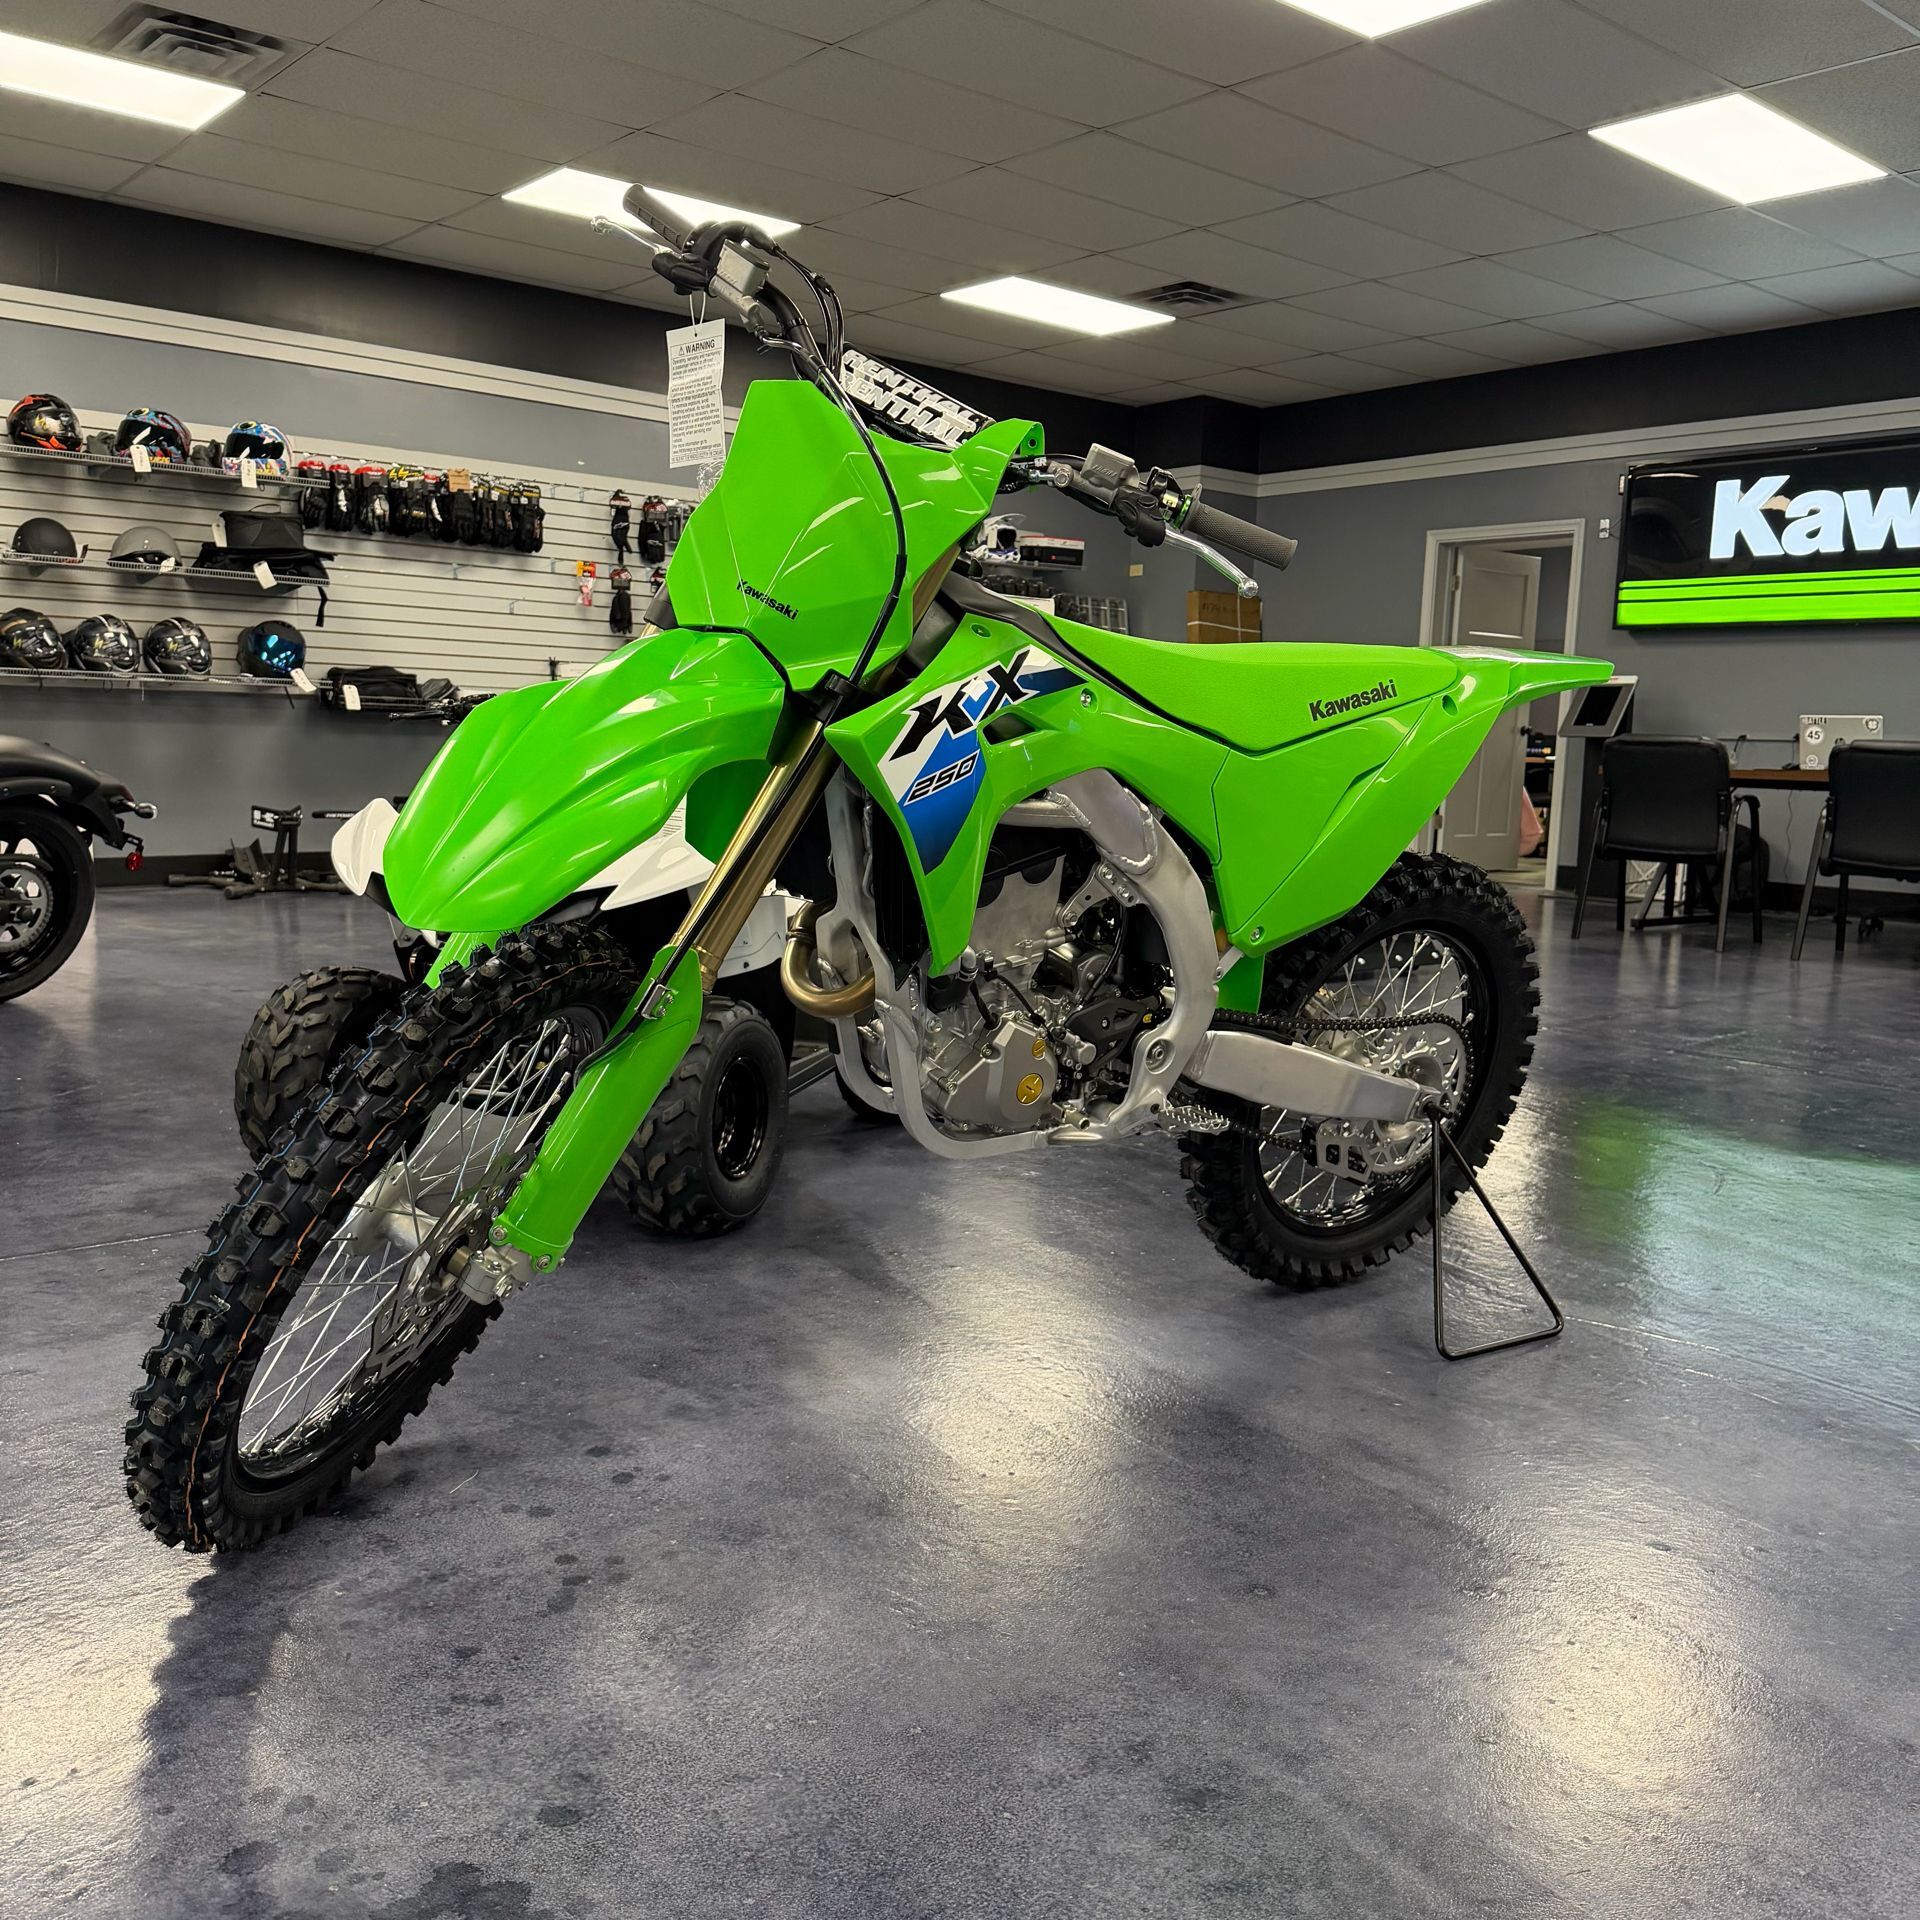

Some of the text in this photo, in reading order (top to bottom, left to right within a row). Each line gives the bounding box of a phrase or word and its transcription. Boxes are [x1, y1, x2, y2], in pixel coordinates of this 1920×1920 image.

[685, 339, 715, 354] WARNING
[840, 371, 966, 446] RENTHAL
[842, 350, 976, 431] RENTHAL
[1709, 475, 1920, 559] Kaw
[737, 579, 799, 620] Kawasaki
[888, 649, 1031, 762] KX
[1308, 679, 1398, 722] Kawasaki
[906, 752, 978, 804] 250
